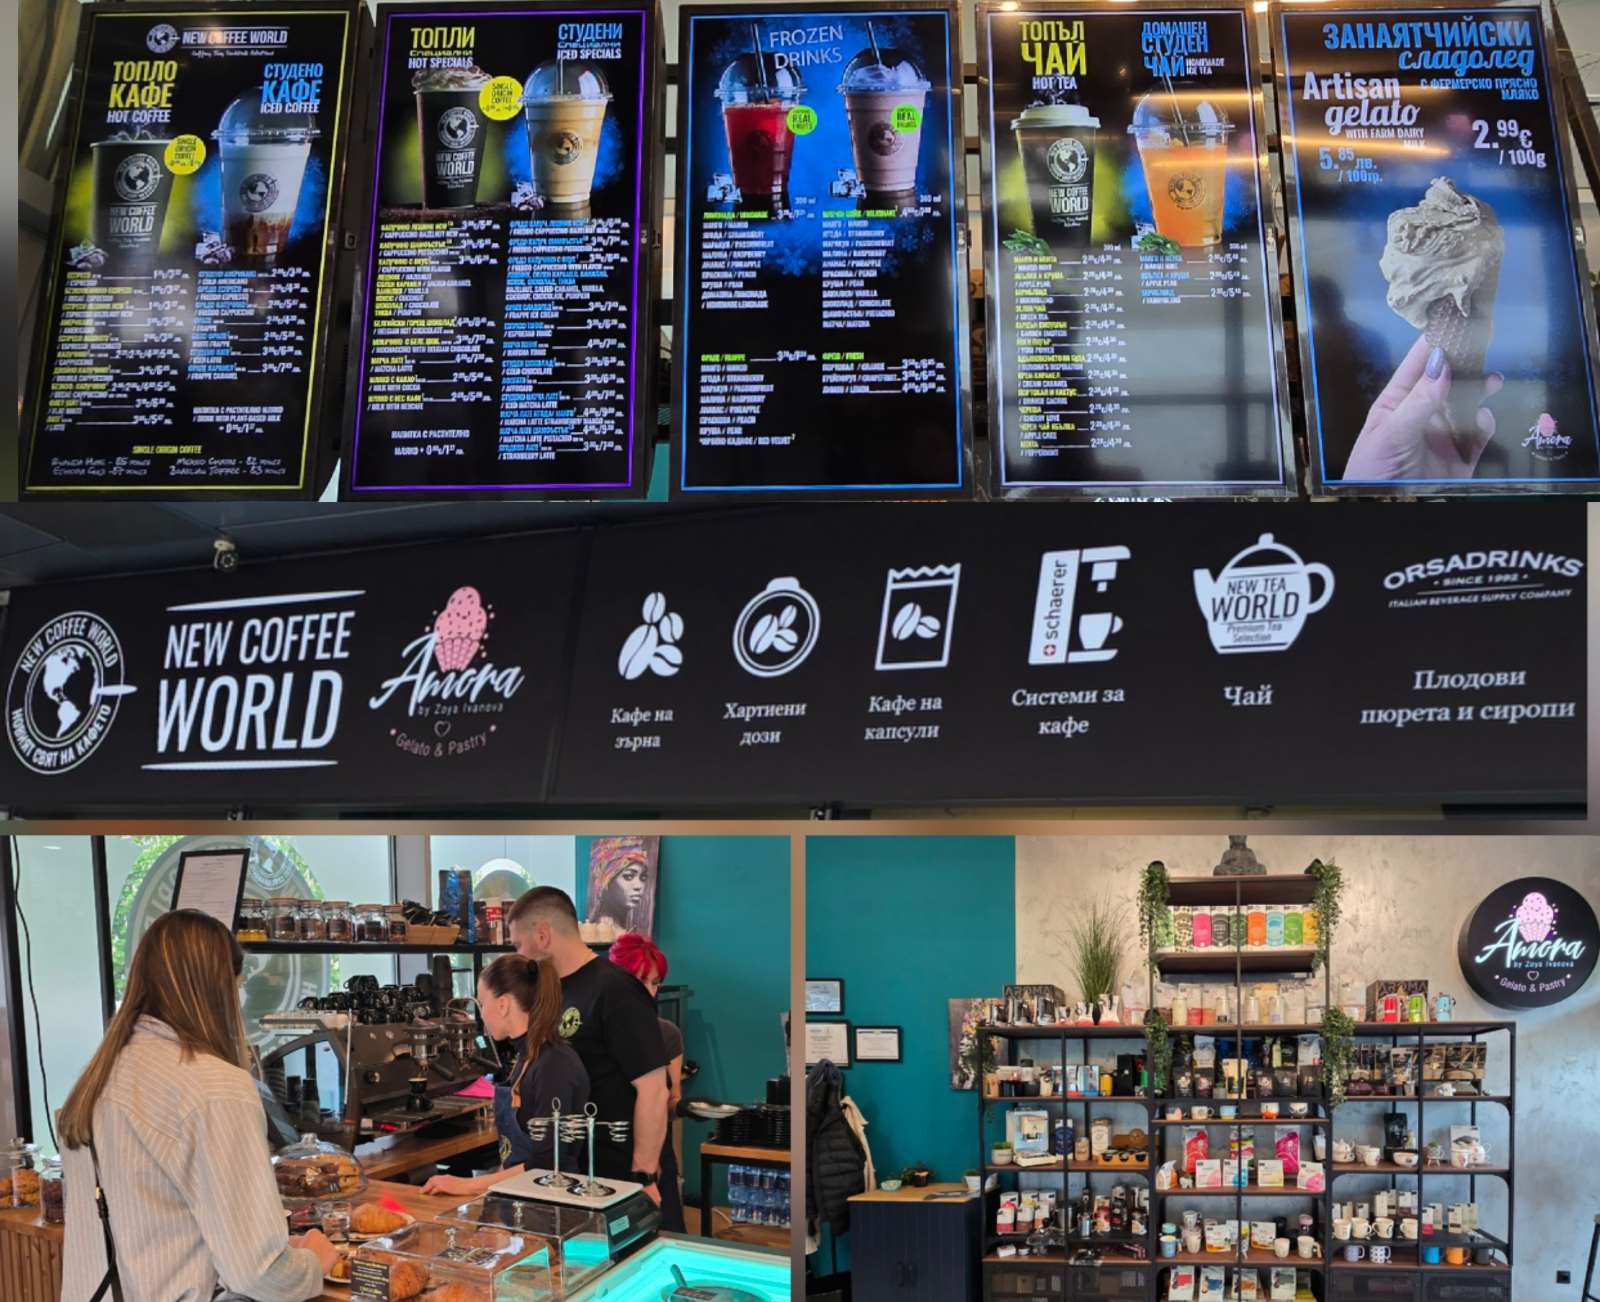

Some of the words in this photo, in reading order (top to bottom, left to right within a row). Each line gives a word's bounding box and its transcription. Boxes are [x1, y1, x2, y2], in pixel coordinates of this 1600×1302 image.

[182, 31, 206, 45] NEW
[249, 30, 288, 44] WORLD
[410, 26, 475, 49] ТОПЛИ
[558, 23, 623, 42] СТУДЕНИ
[769, 25, 843, 48] FROZEN
[1019, 20, 1085, 41] ТОПЪЛ
[1142, 21, 1207, 36] ДОМАШЕН
[1322, 16, 1532, 49] ЗАНАЯТЧИЙСКИ
[557, 49, 578, 60] ICED
[579, 48, 622, 60] SPECIALS
[1141, 33, 1208, 56] СТУДЕН
[408, 57, 428, 69] HOT
[430, 57, 474, 69] SPECIALS
[774, 47, 843, 70] DRINKS
[1020, 41, 1087, 76] ЧАЙ
[1399, 49, 1535, 77] сладолед
[113, 60, 178, 82] ТОПЛО
[264, 63, 323, 79] СТУДЕНО
[261, 79, 321, 105] КАФЕ
[1032, 76, 1054, 90] HOT
[1056, 76, 1078, 90] TEA
[1303, 71, 1401, 100] Artisan
[1495, 78, 1538, 90] ПРЯСНО
[108, 82, 176, 109] КАФЕ
[1501, 89, 1539, 100] МЛЯКО
[106, 110, 129, 124] HOT
[131, 109, 171, 123] COFFEE
[260, 102, 282, 114] ICED
[284, 102, 319, 114] COFFEE
[1325, 98, 1420, 137] gelato
[1370, 128, 1395, 139] FARM
[1397, 127, 1424, 139] DAIRY
[436, 160, 475, 177] WORLD
[1049, 196, 1089, 213] WORLD
[110, 216, 154, 233] WORLD
[1383, 550, 1584, 590] ORSADRINKS
[1227, 579, 1259, 594] NEW
[1262, 577, 1287, 593] TEA
[1443, 575, 1483, 587] SINCE
[1044, 559, 1068, 640] schaerer
[1211, 591, 1300, 623] WORLD
[1388, 599, 1428, 609] ITALIAN
[1429, 595, 1479, 607] BEVERAGE
[1480, 592, 1517, 604] SUPPLY
[1519, 588, 1573, 601] COMPANY
[20, 637, 45, 673] NEW
[45, 617, 88, 645] COFFEE
[87, 623, 119, 668] WORLD
[163, 620, 234, 669] NEW
[239, 611, 355, 665] COFFEE
[368, 630, 526, 718] Amora
[1413, 669, 1527, 692] Плодови
[868, 695, 916, 716] Кафе
[919, 696, 943, 711] на
[1011, 688, 1098, 707] Системи
[1102, 688, 1125, 702] за
[1223, 684, 1274, 707] Чай
[156, 669, 344, 753] WORLD
[610, 707, 651, 727] Кафе
[653, 708, 674, 723] на
[723, 701, 807, 722] Хартиени
[1360, 705, 1451, 727] пюрета
[1457, 706, 1473, 720] и
[1479, 701, 1576, 724] сиропи
[60, 748, 75, 765] НА
[75, 704, 112, 755] КАФЕТО
[739, 728, 782, 746] дози
[864, 723, 940, 743] капсули
[1038, 717, 1089, 738] кафе
[396, 732, 430, 757] Gelato
[434, 742, 443, 757] &
[448, 732, 487, 755] Pastry
[614, 733, 662, 754] зърна
[1475, 917, 1586, 969] Amora
[1539, 978, 1566, 992] Pastry
